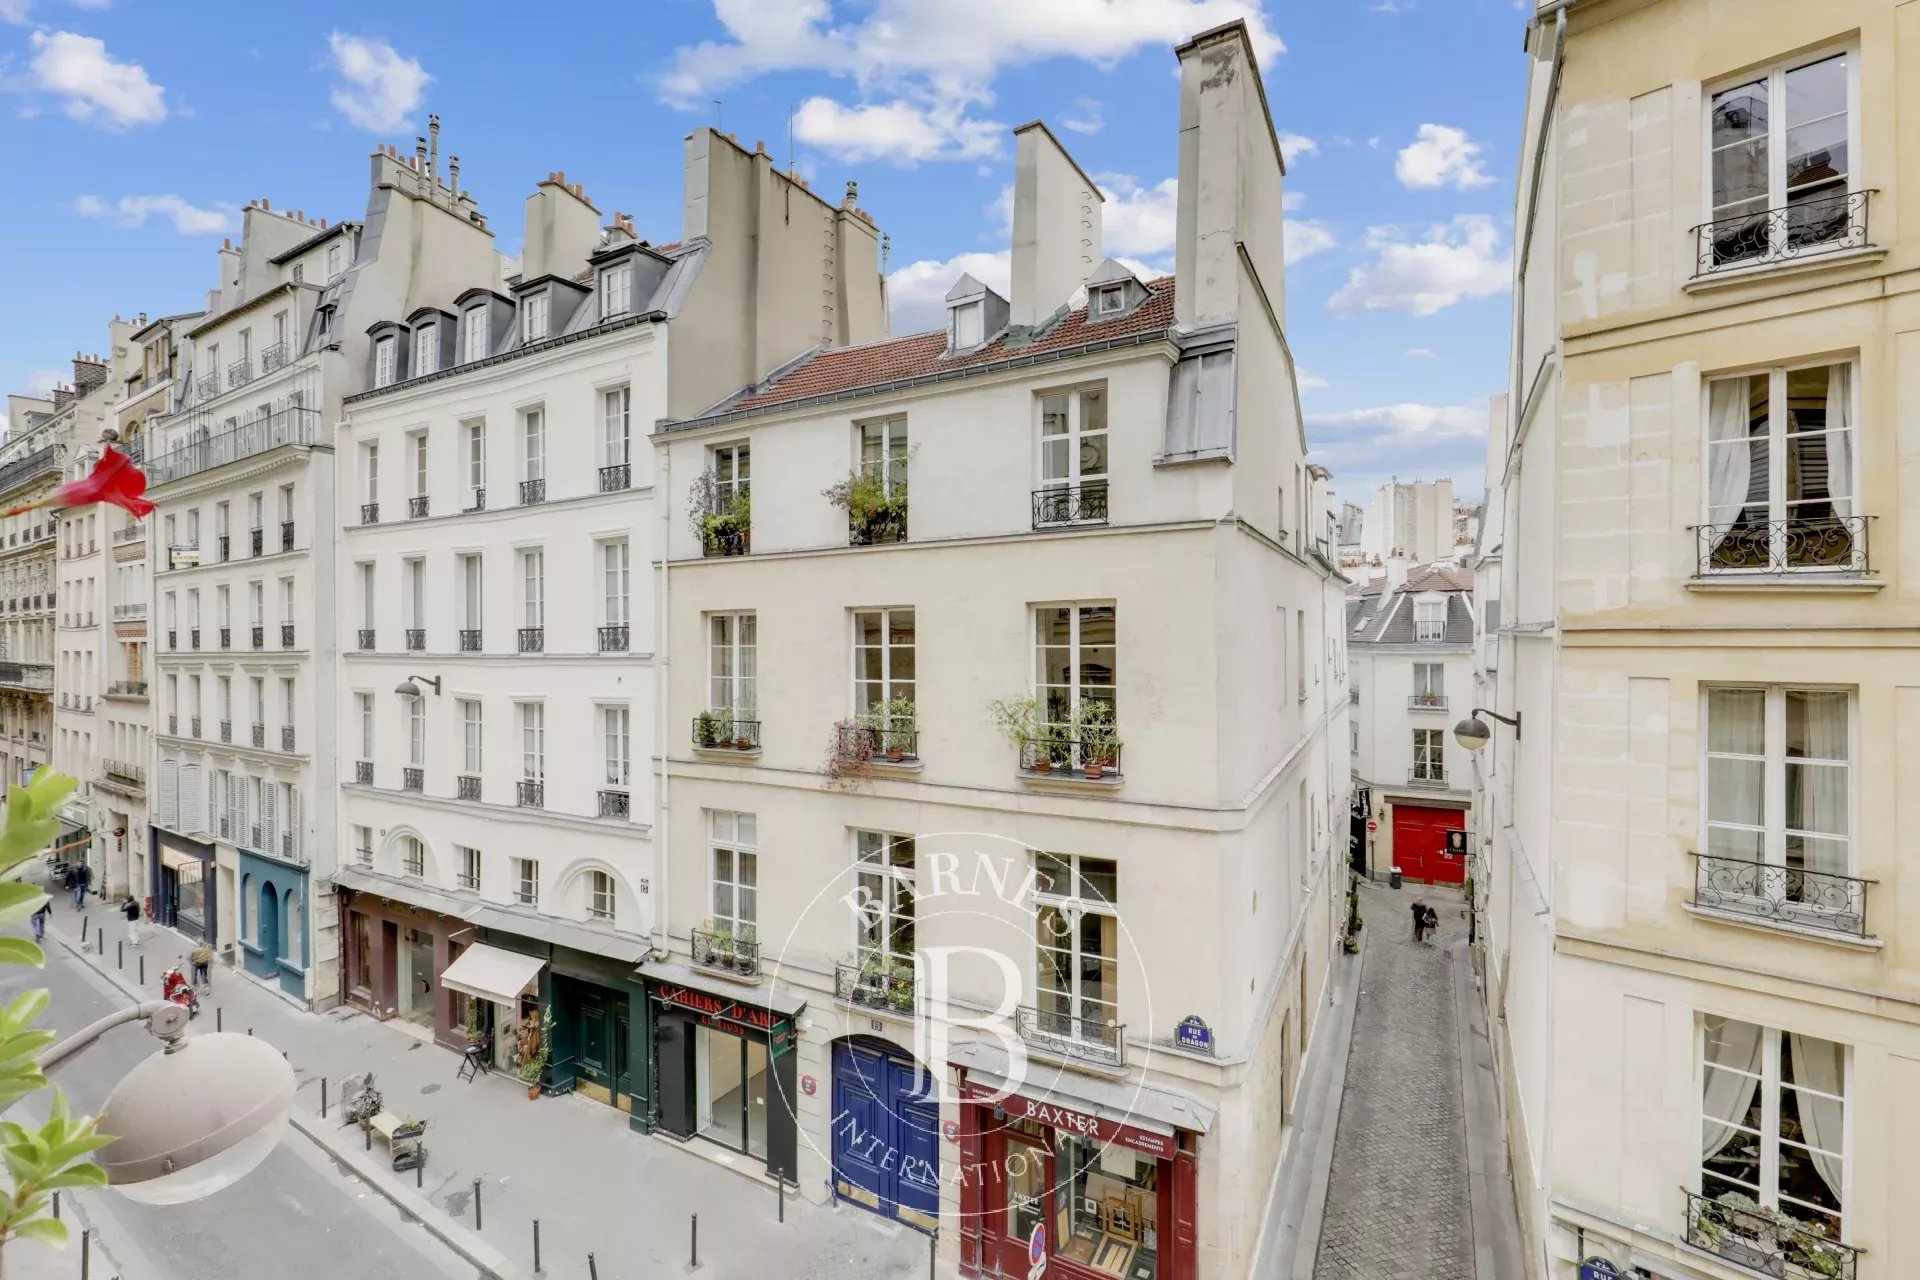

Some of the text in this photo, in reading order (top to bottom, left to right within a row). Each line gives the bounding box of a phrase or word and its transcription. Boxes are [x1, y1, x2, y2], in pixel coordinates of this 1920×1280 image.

[659, 984, 780, 1029] CAHIERS D'ART
[1188, 1027, 1201, 1036] RUE
[1181, 1036, 1209, 1049] DRAGON
[1027, 1101, 1099, 1136] BAXTER
[1125, 1137, 1164, 1152] ENCADREMENTS
[1139, 1135, 1164, 1146] ESTAMPES
